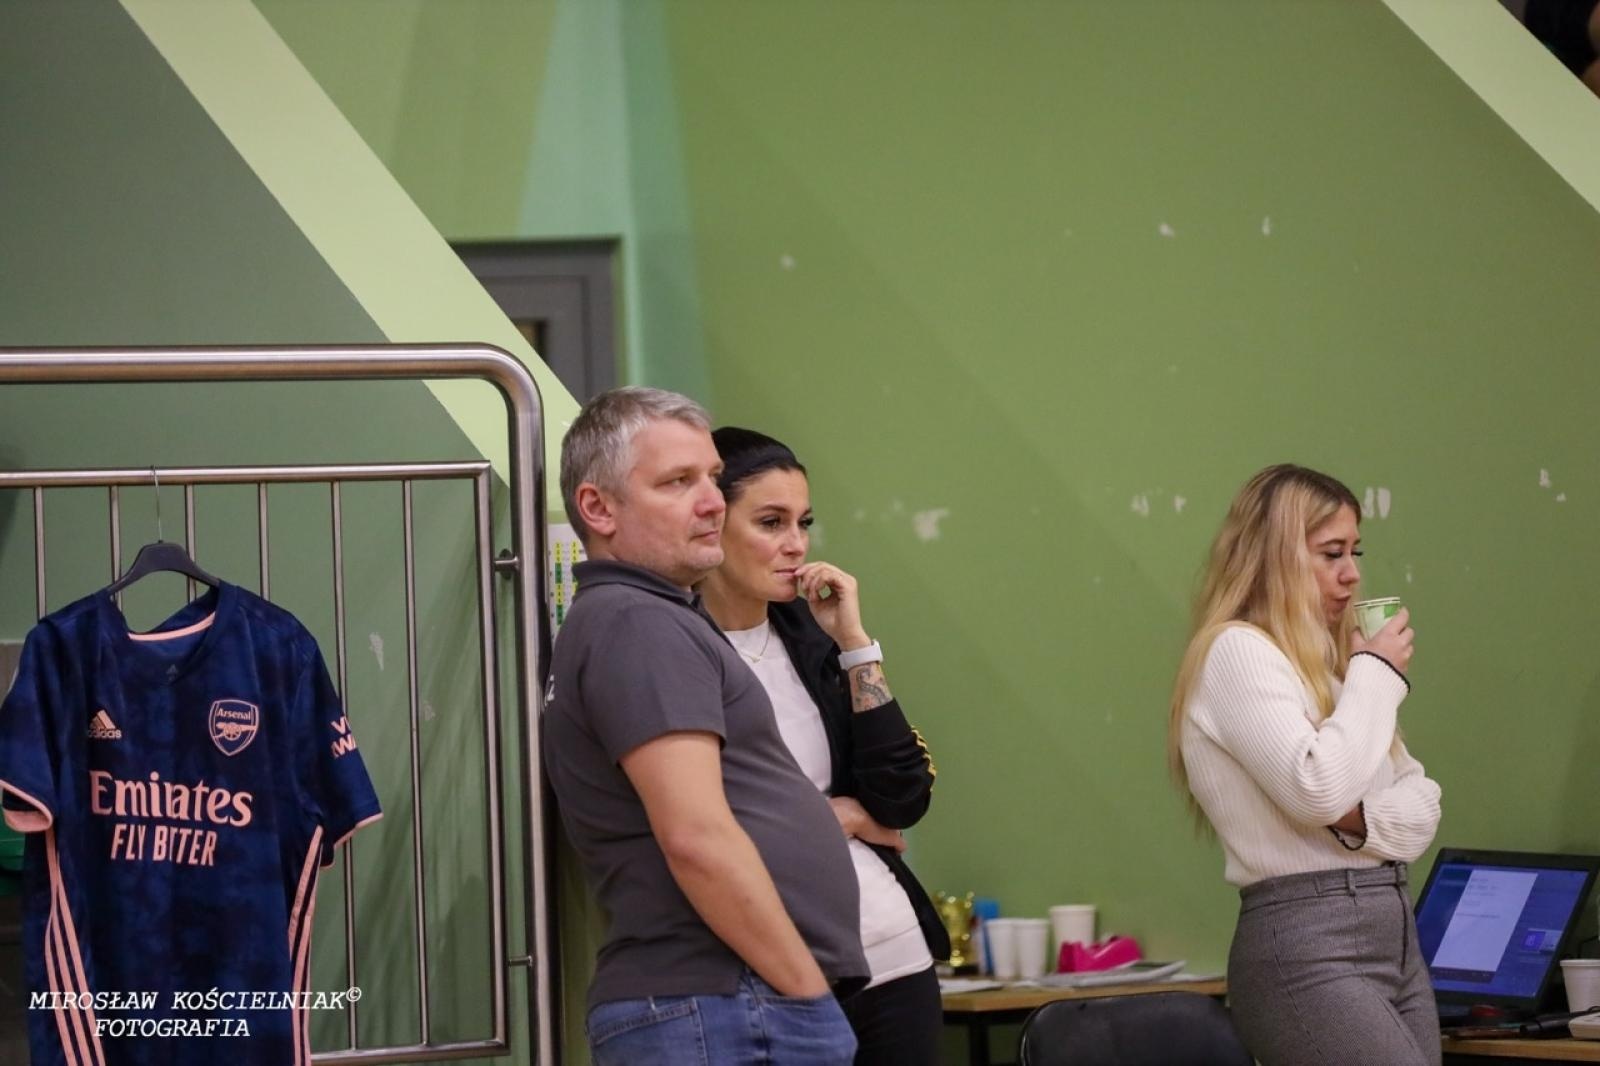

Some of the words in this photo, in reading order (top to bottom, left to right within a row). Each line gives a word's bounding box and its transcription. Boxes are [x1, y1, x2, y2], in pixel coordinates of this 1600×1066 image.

[214, 707, 251, 720] Arsenal
[89, 770, 253, 827] Emirates
[110, 823, 146, 861] FLY
